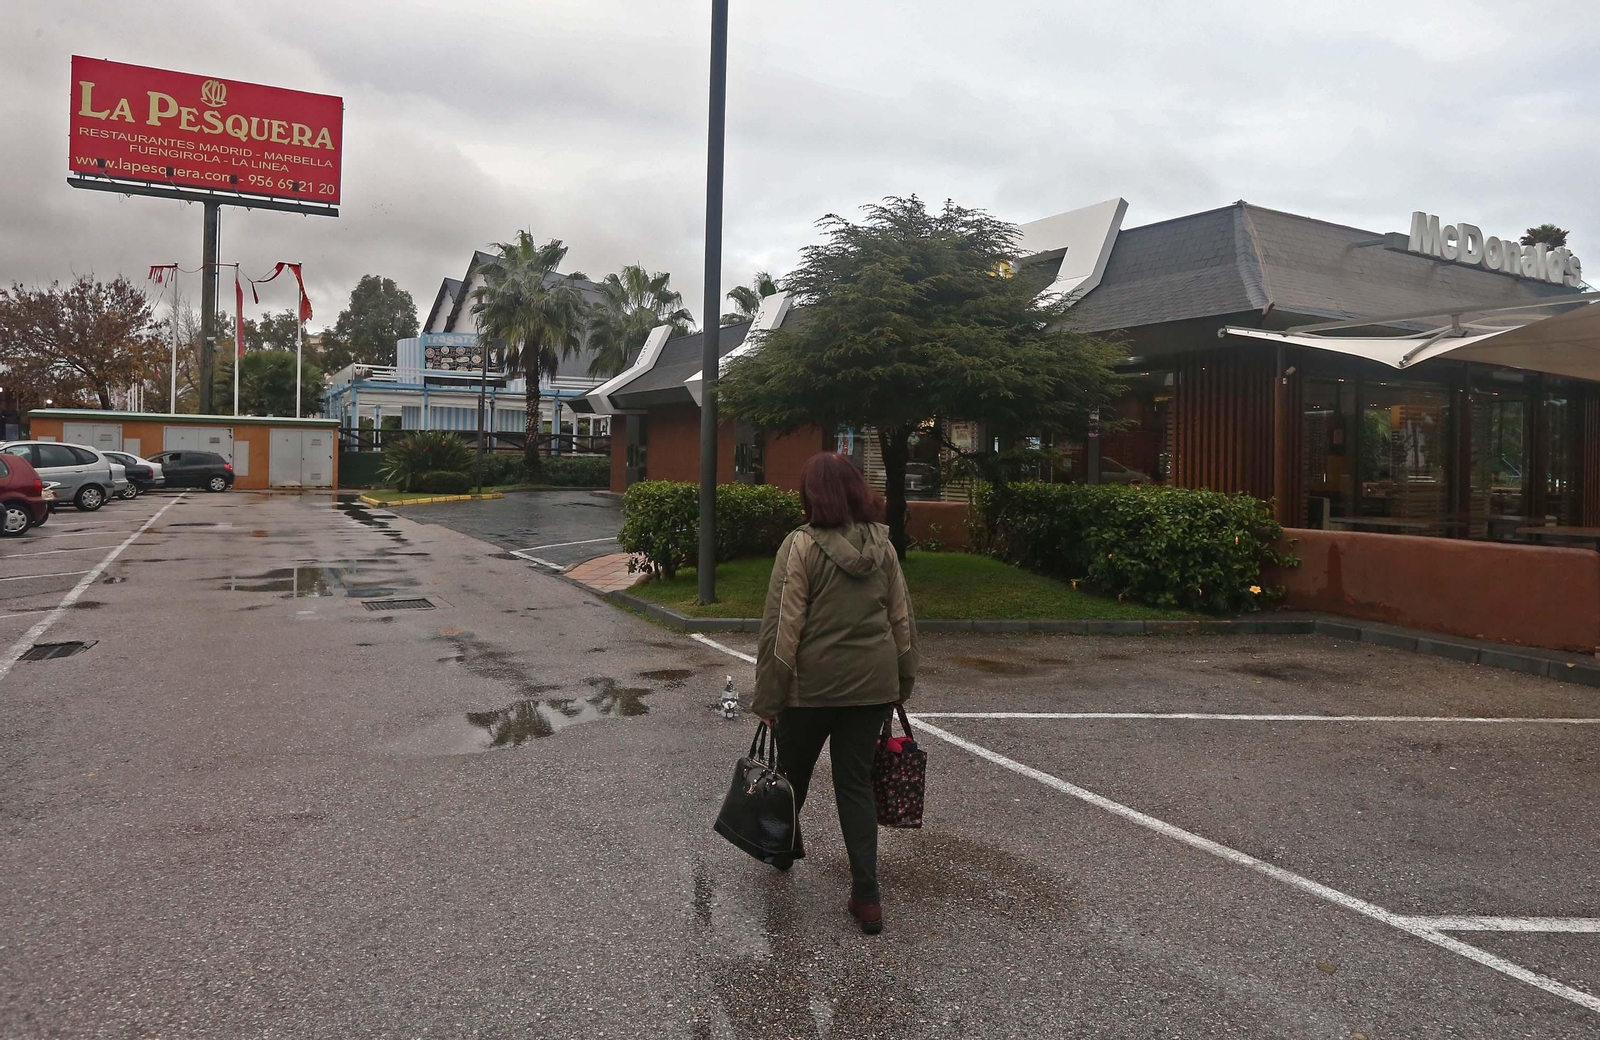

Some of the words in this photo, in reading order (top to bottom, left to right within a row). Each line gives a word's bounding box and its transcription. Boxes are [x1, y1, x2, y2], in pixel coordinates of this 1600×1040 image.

[78, 80, 135, 122] LA
[146, 90, 335, 150] PESQUERA
[79, 126, 195, 150] RESTAURANTES
[199, 142, 252, 158] MADRID
[264, 151, 333, 168] MARBELLA
[129, 144, 220, 164] FUENGIROLA
[232, 157, 249, 167] LA
[251, 160, 290, 173] LINEA
[248, 174, 274, 188] 956
[277, 178, 294, 190] 69
[298, 180, 313, 193] 21
[318, 183, 335, 195] 20
[1408, 211, 1582, 288] McDonald's
